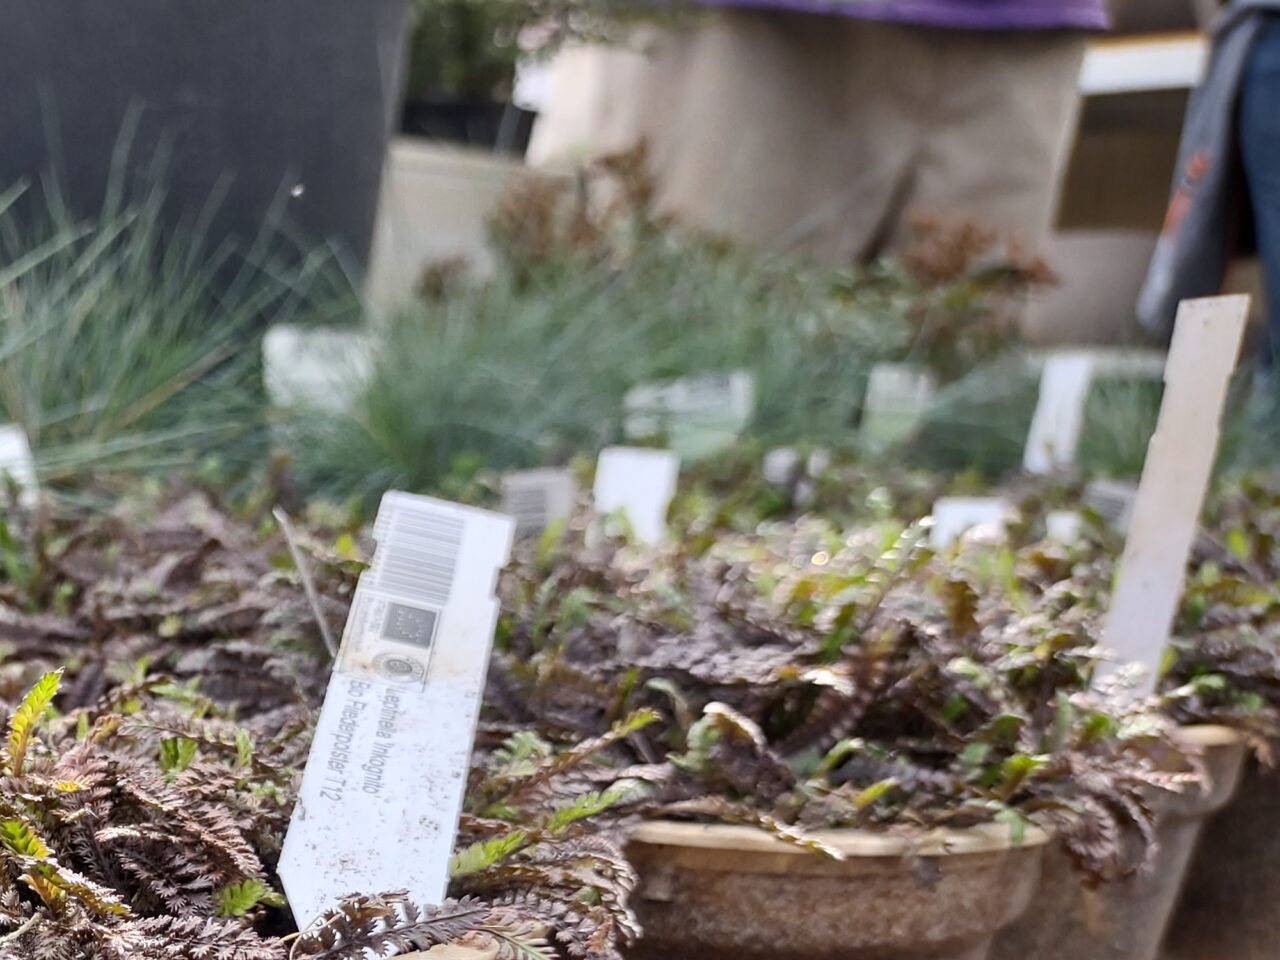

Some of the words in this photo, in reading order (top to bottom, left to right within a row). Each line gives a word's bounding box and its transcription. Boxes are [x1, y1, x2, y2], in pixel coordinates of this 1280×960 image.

[346, 680, 370, 698] Bio
[375, 687, 402, 739] Leptinella
[327, 699, 367, 776] Fliederpolster
[319, 778, 347, 801] T12
